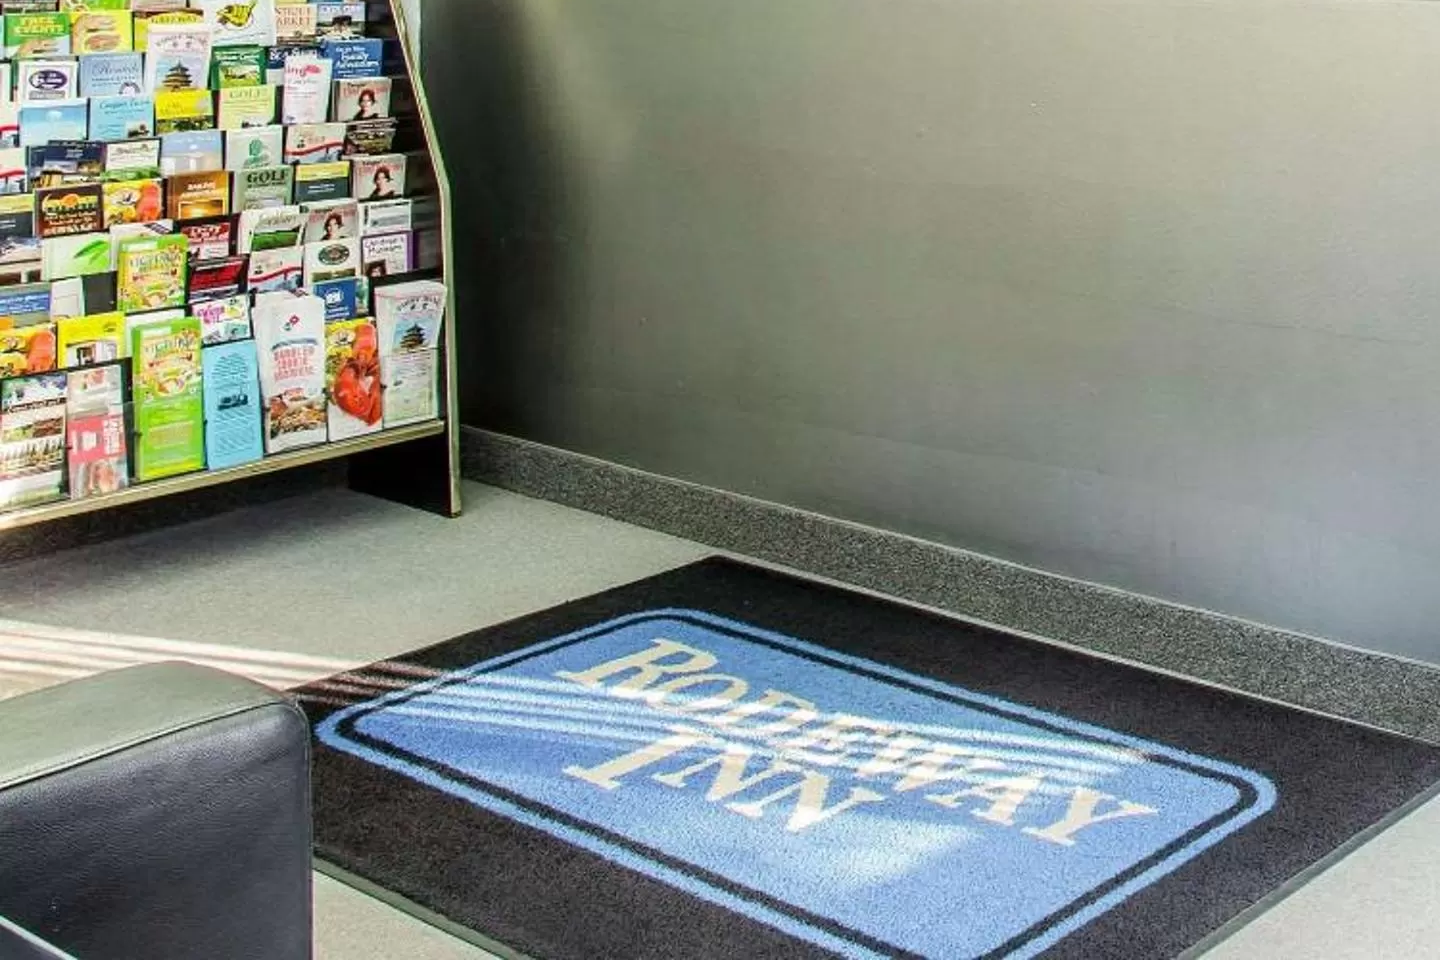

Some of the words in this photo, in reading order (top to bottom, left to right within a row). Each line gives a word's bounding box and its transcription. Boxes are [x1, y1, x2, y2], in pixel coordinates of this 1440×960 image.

[247, 169, 289, 183] GOLF
[556, 637, 1160, 846] RODEWAY
[563, 725, 884, 833] INN
